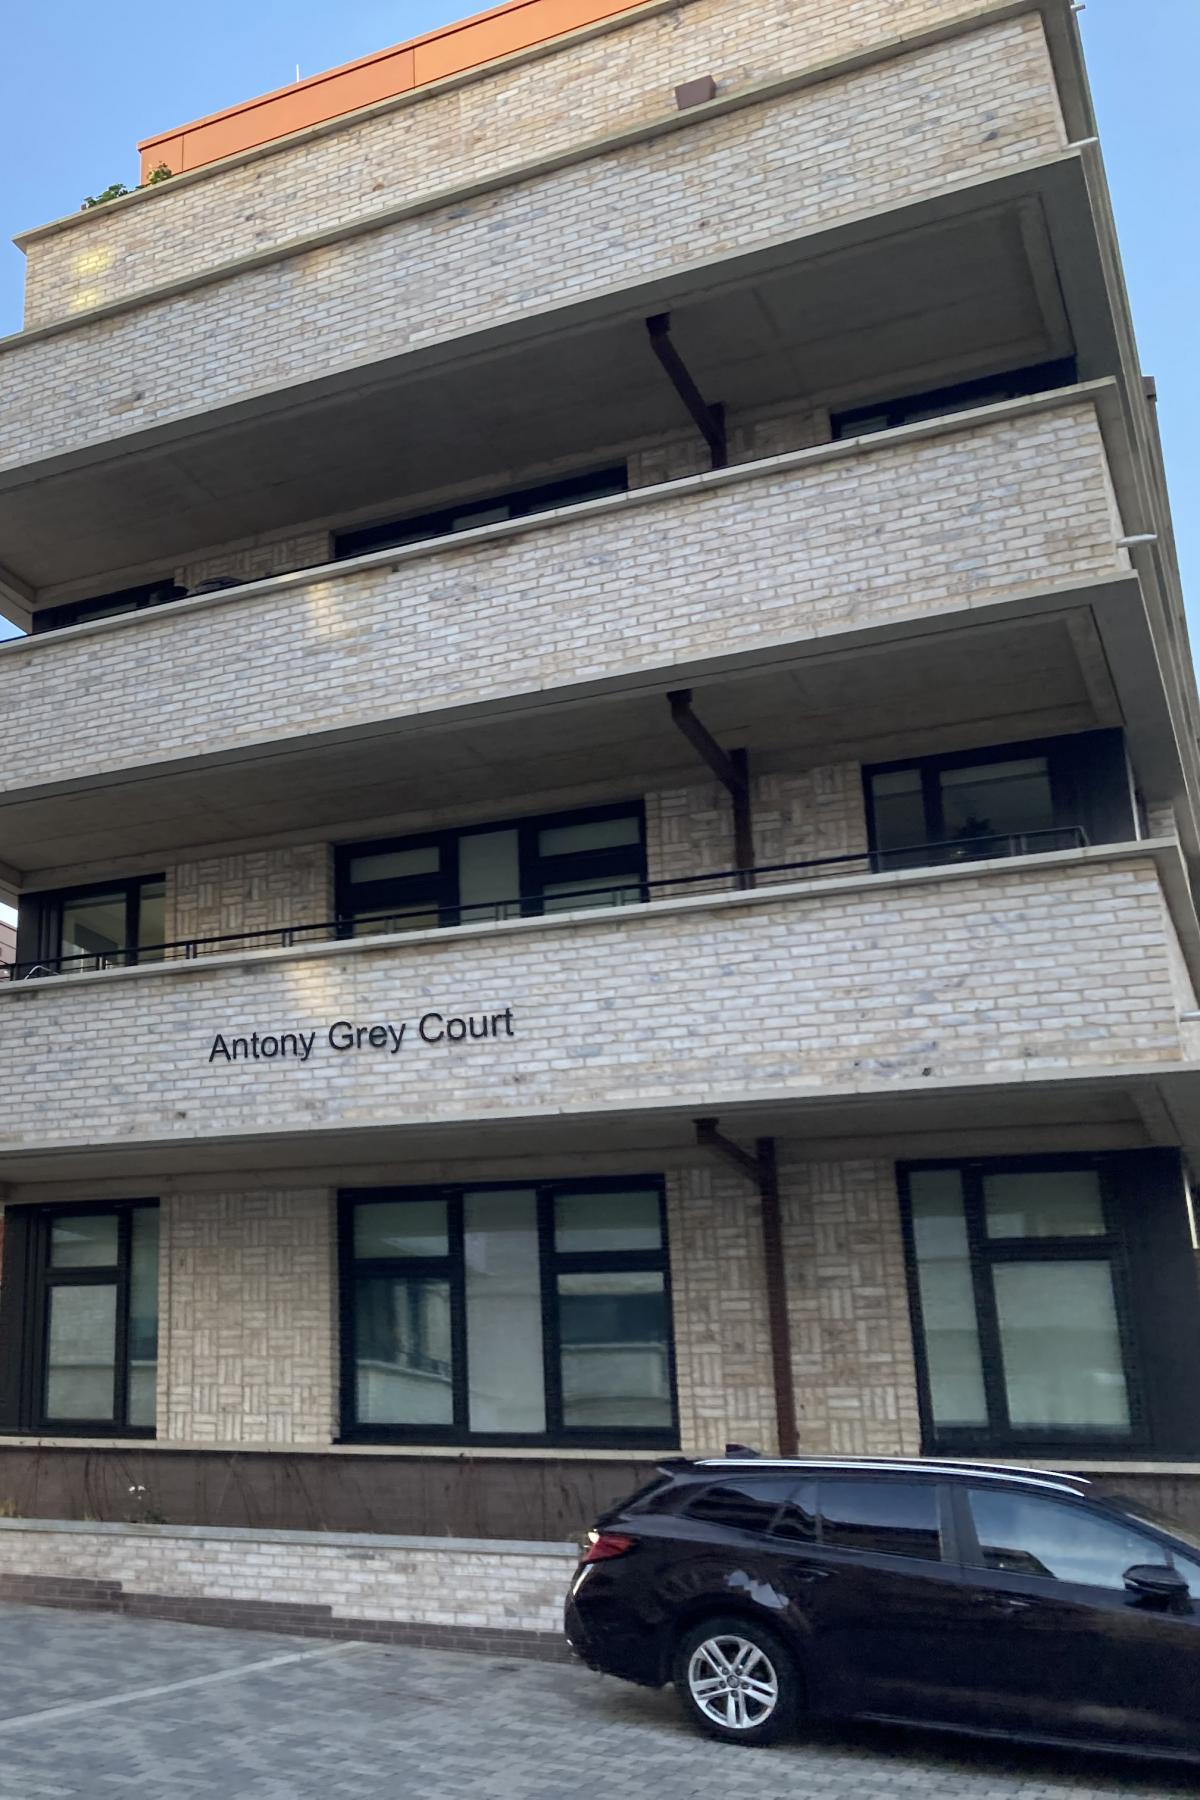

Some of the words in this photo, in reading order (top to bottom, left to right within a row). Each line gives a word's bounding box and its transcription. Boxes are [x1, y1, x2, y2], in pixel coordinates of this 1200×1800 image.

[208, 1031, 316, 1062] Antony
[328, 1021, 407, 1054] Grey
[418, 1008, 515, 1043] Court
